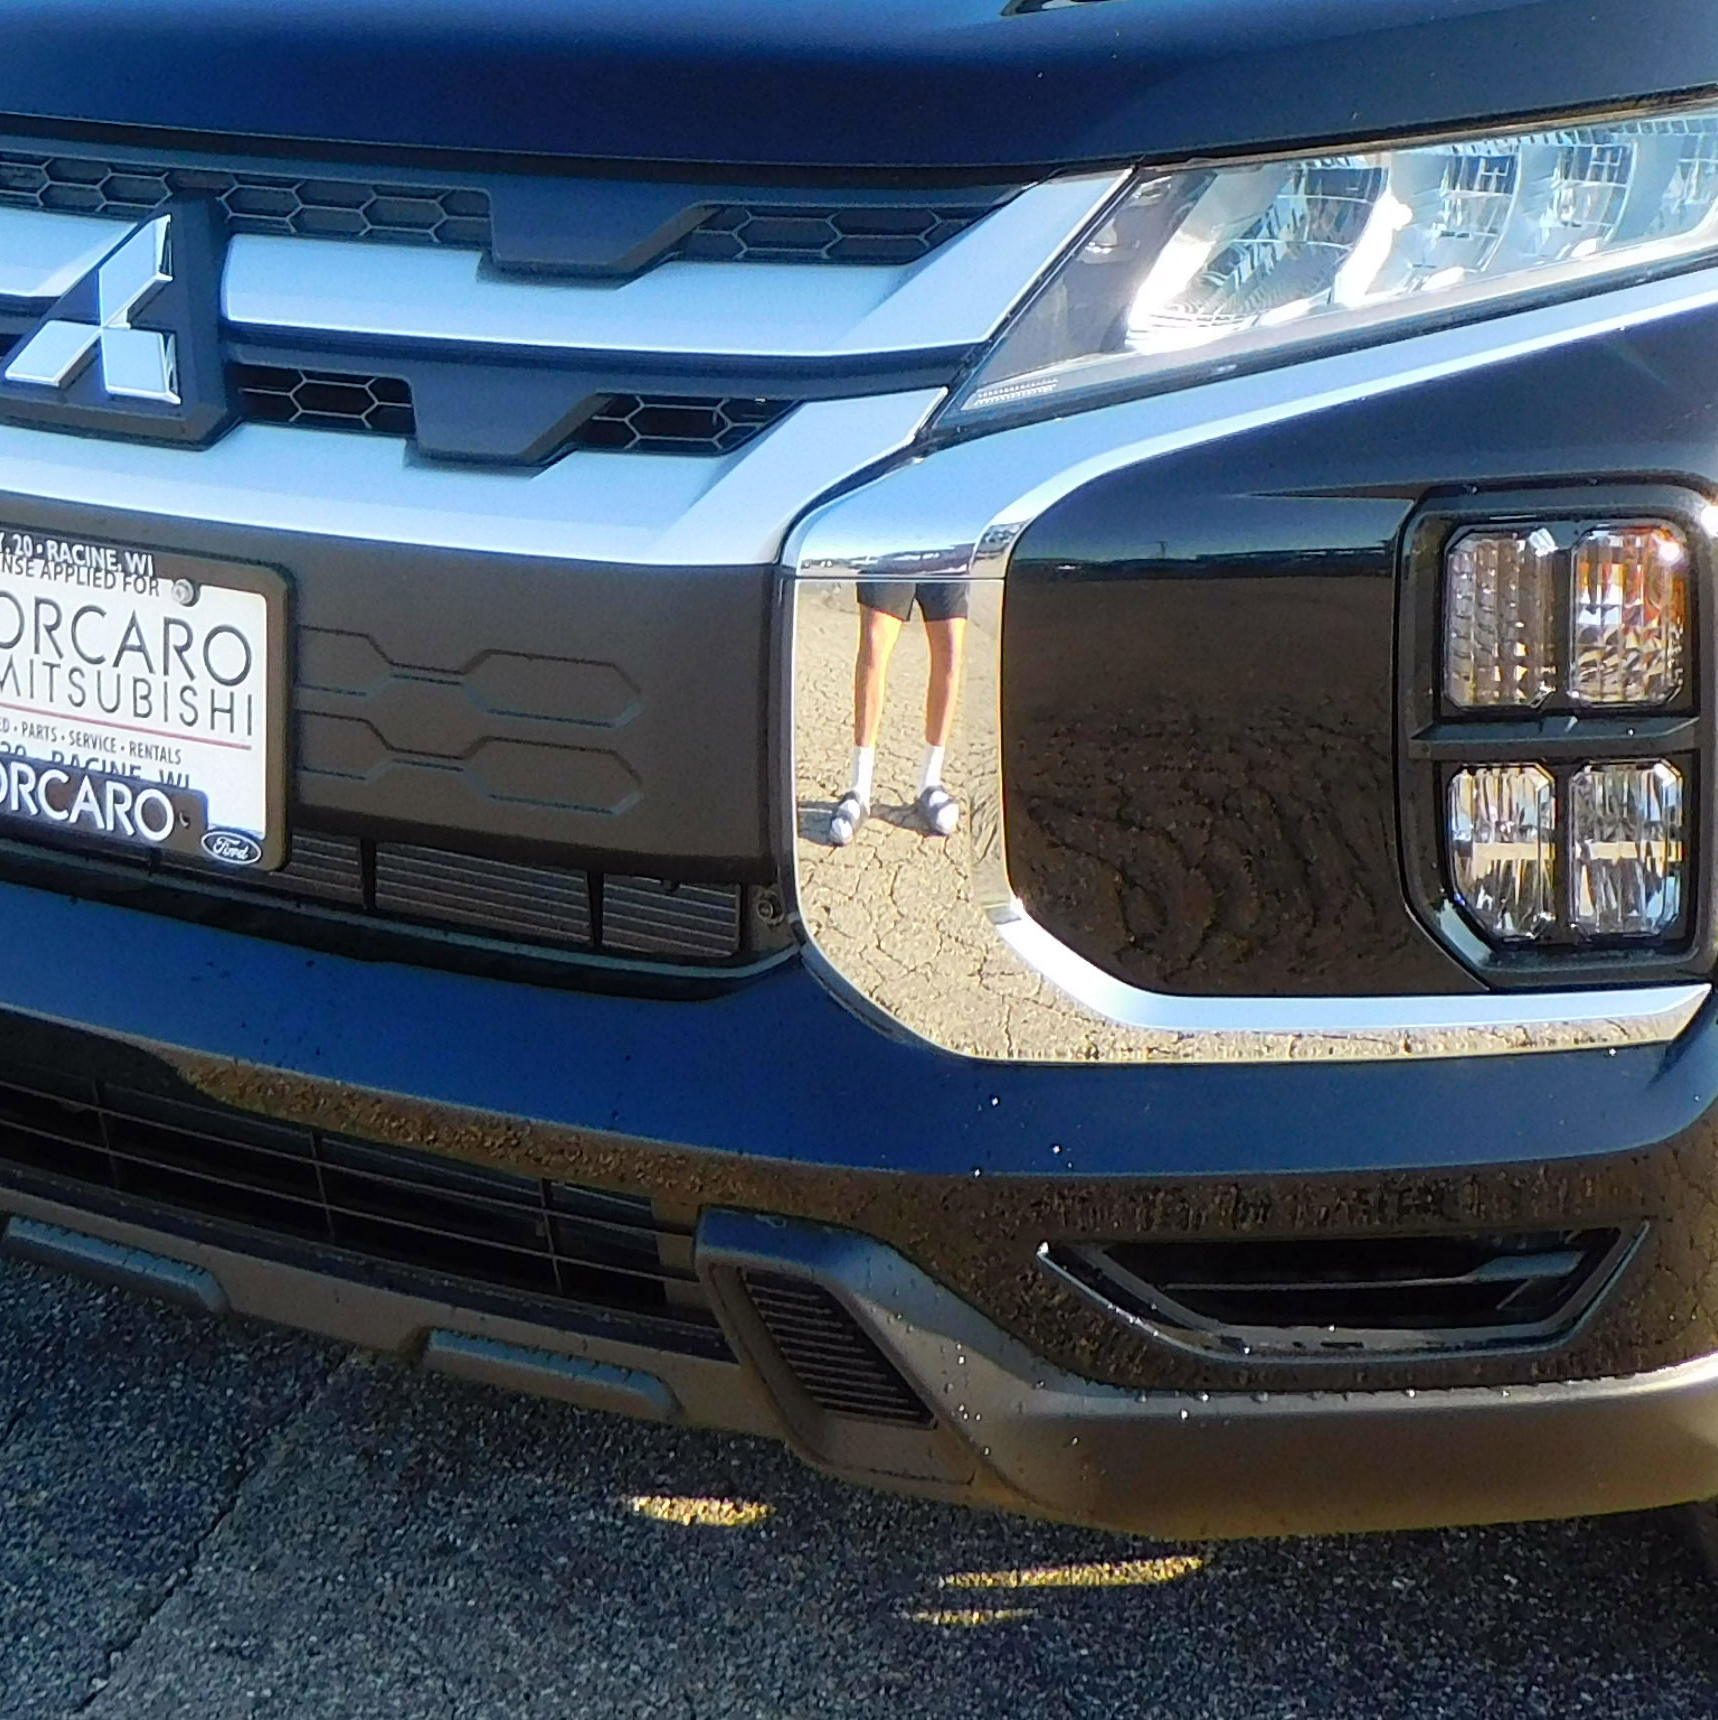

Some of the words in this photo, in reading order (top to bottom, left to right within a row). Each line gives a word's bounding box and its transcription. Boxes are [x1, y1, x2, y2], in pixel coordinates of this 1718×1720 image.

[12, 533, 33, 557] 20
[125, 551, 154, 577] WI
[40, 561, 116, 590] APPLIED
[122, 575, 160, 597] FOR
[21, 721, 57, 743] PARTS
[69, 729, 117, 754] SERVICE
[128, 741, 182, 765] RENTALS
[213, 836, 249, 860] Ford
